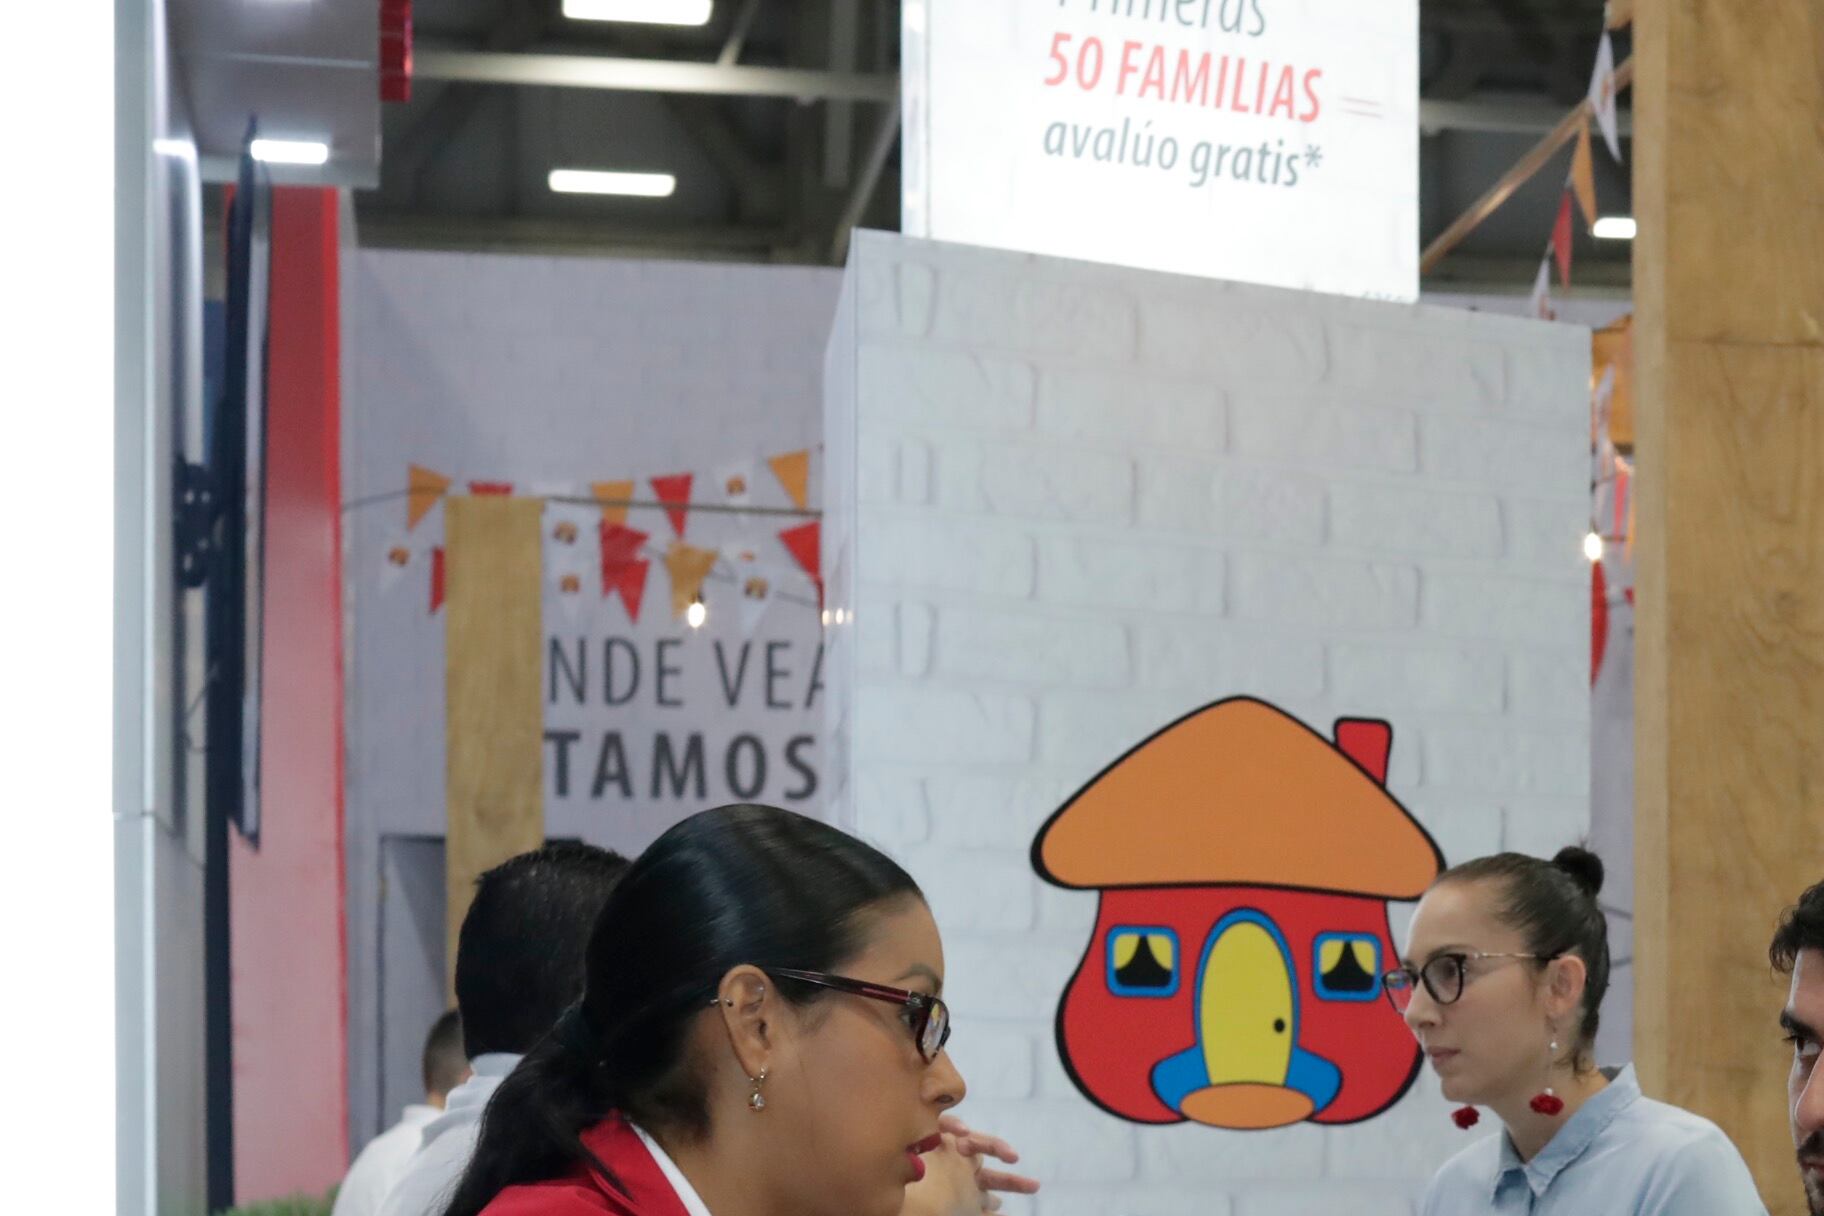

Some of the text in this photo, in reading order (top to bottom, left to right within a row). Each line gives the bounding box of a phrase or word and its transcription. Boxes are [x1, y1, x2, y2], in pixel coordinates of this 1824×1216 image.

[1043, 31, 1324, 124] 50 FAMILIAS
[1043, 116, 1179, 170] avalúo
[544, 731, 817, 801] TAMOS
